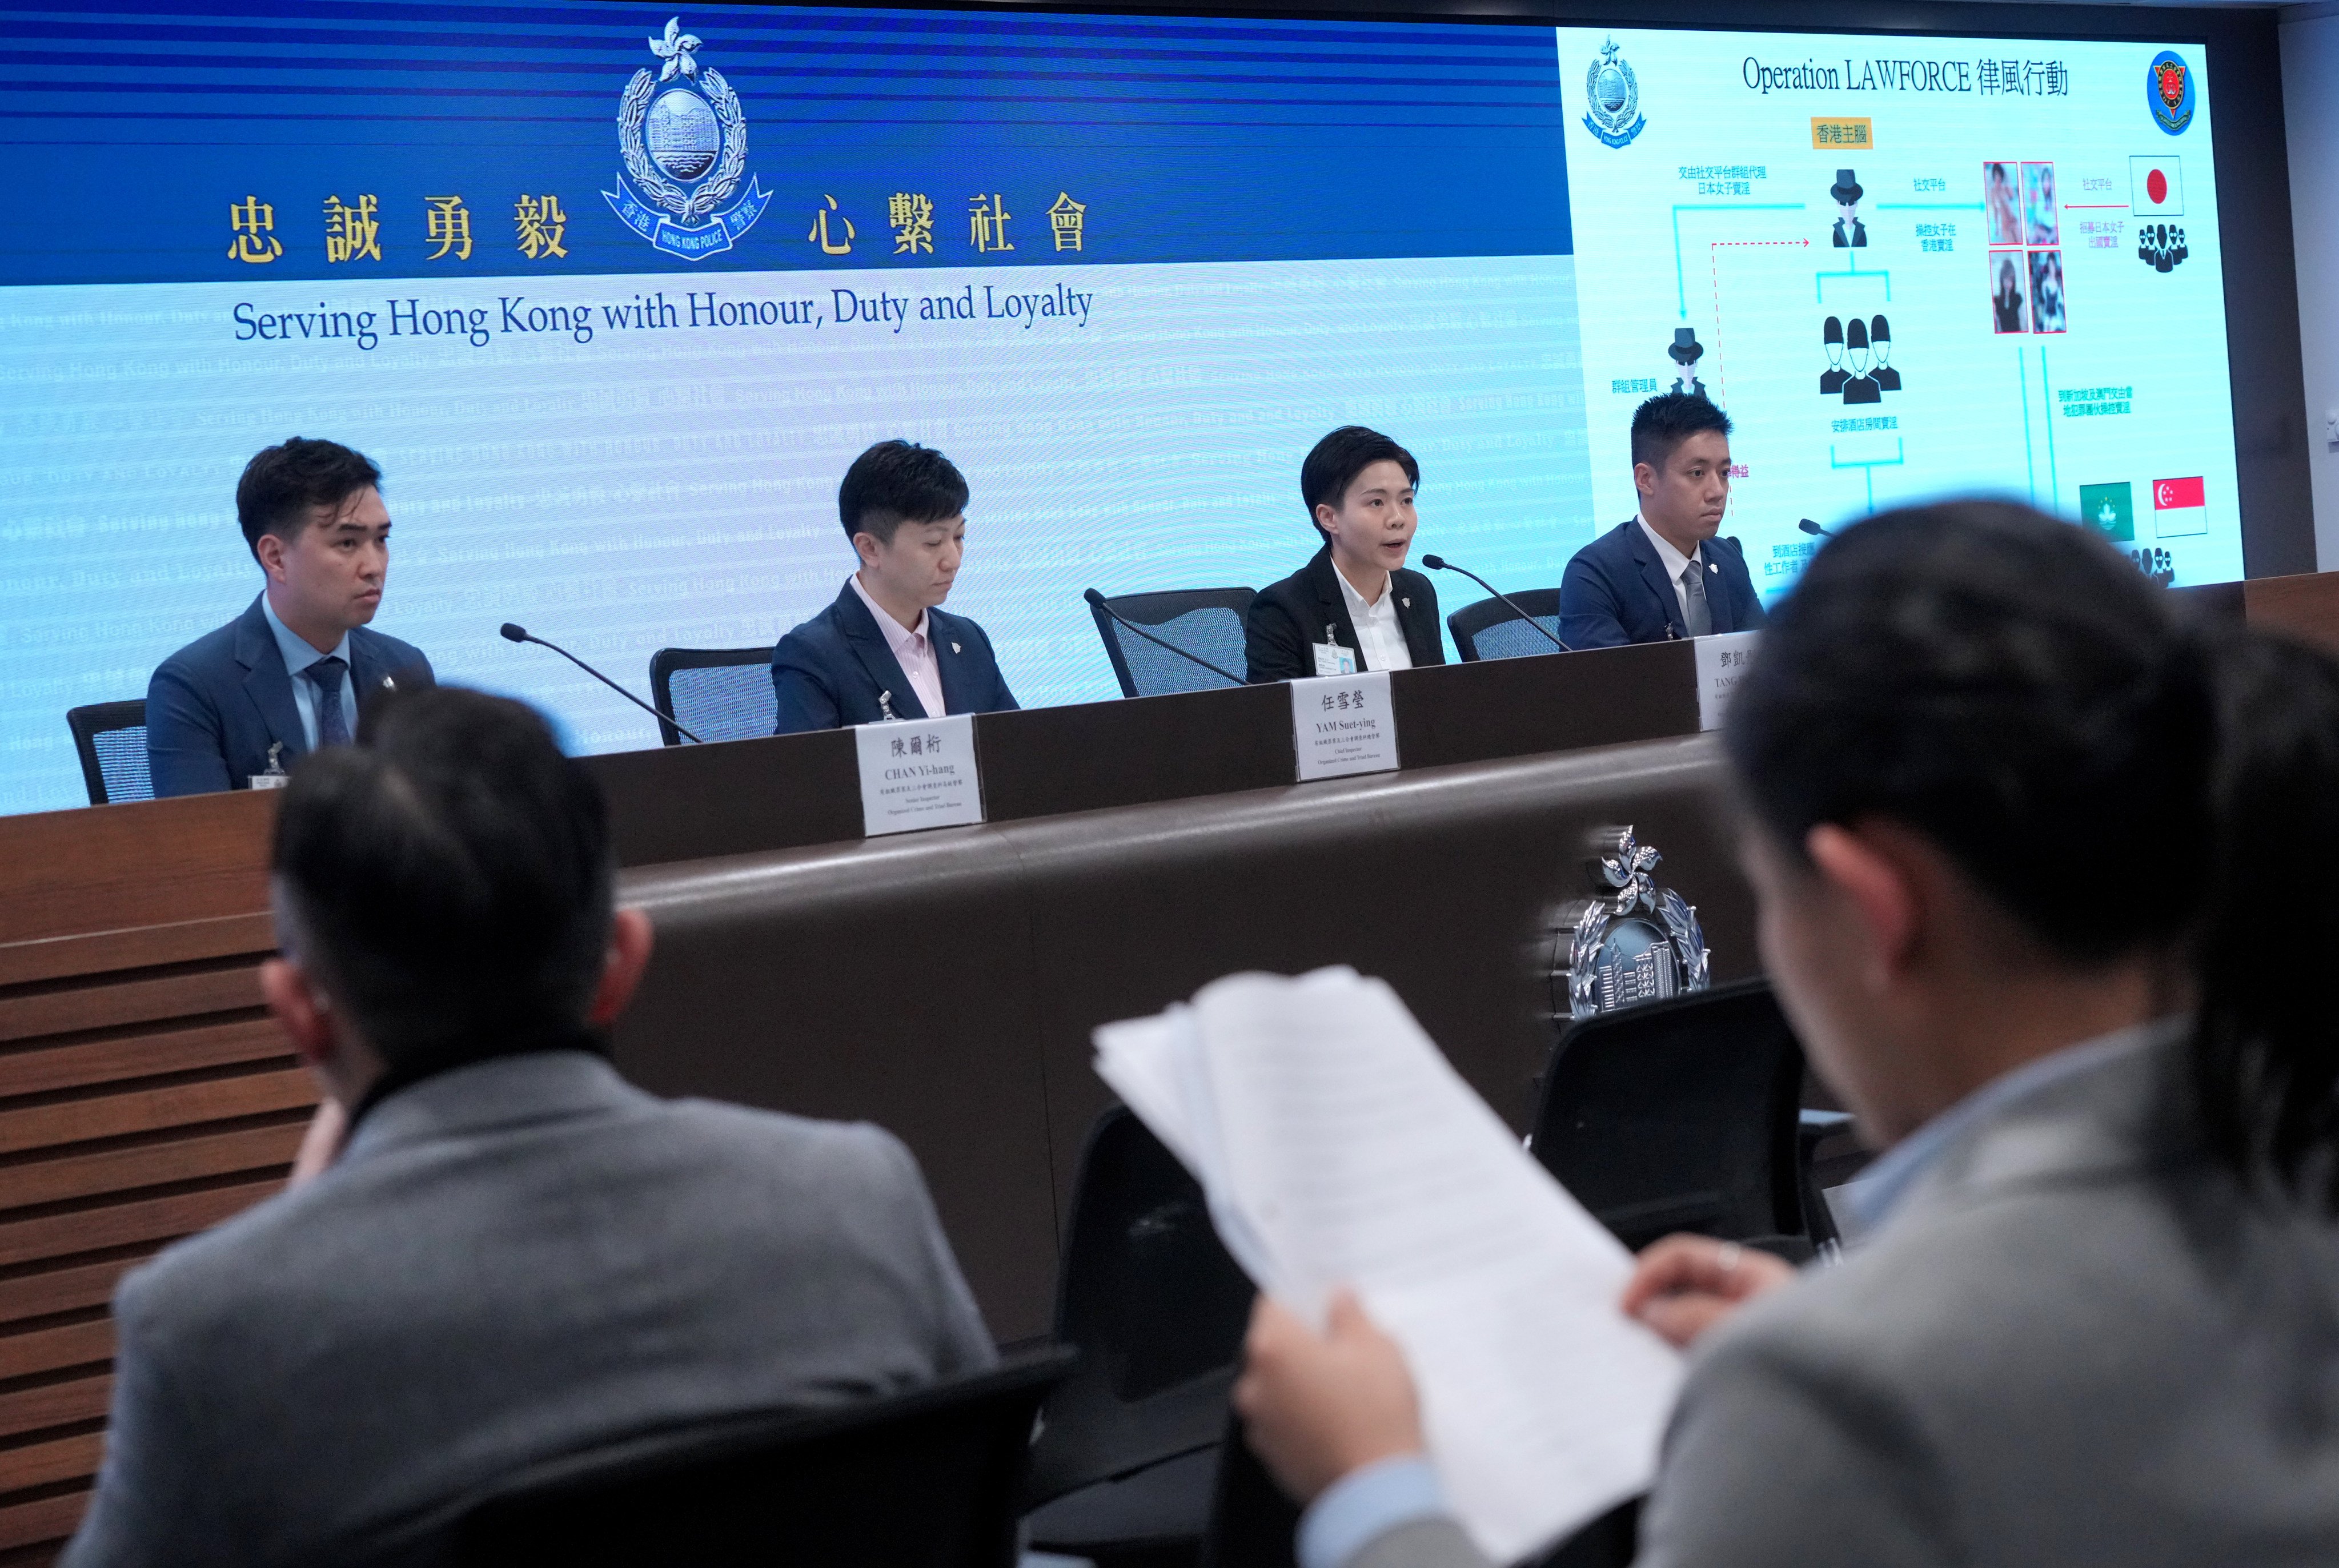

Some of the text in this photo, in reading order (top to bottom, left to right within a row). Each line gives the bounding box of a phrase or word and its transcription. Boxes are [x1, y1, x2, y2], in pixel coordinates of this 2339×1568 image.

[1743, 57, 2068, 97] Operation LAWFORCE 律風行動
[1816, 124, 1867, 144] 香港主腦
[1678, 166, 1767, 180] 交由社交平台群組代理
[1698, 182, 1751, 195] 日本女子賣淫
[1913, 178, 1946, 192] 社交平台
[2083, 178, 2113, 191] 社交平台
[621, 202, 650, 232] 香港
[807, 191, 1088, 255] 心繫社會
[227, 194, 568, 264] 忠誠勇毅
[661, 229, 723, 250] HONG KONG POLICE
[1921, 239, 1953, 252] 香港賣淫
[232, 301, 378, 351] Serving
[387, 299, 490, 347] Hong
[498, 296, 593, 344] Kong
[604, 292, 677, 331] with
[687, 290, 824, 329] Honour,
[832, 288, 909, 333] Duty
[920, 284, 974, 320] and
[983, 282, 1094, 329] Loyalty
[1612, 379, 1657, 393] 群組管理員
[1831, 416, 1898, 432] 安排酒店房間賣淫
[1764, 560, 1798, 576] 性工作者
[1714, 676, 1737, 688] TANG
[1321, 689, 1364, 712] 任雪瑩
[1316, 718, 1376, 733] YAM Suet-ying
[885, 764, 956, 780] CHAN Yi-hang
